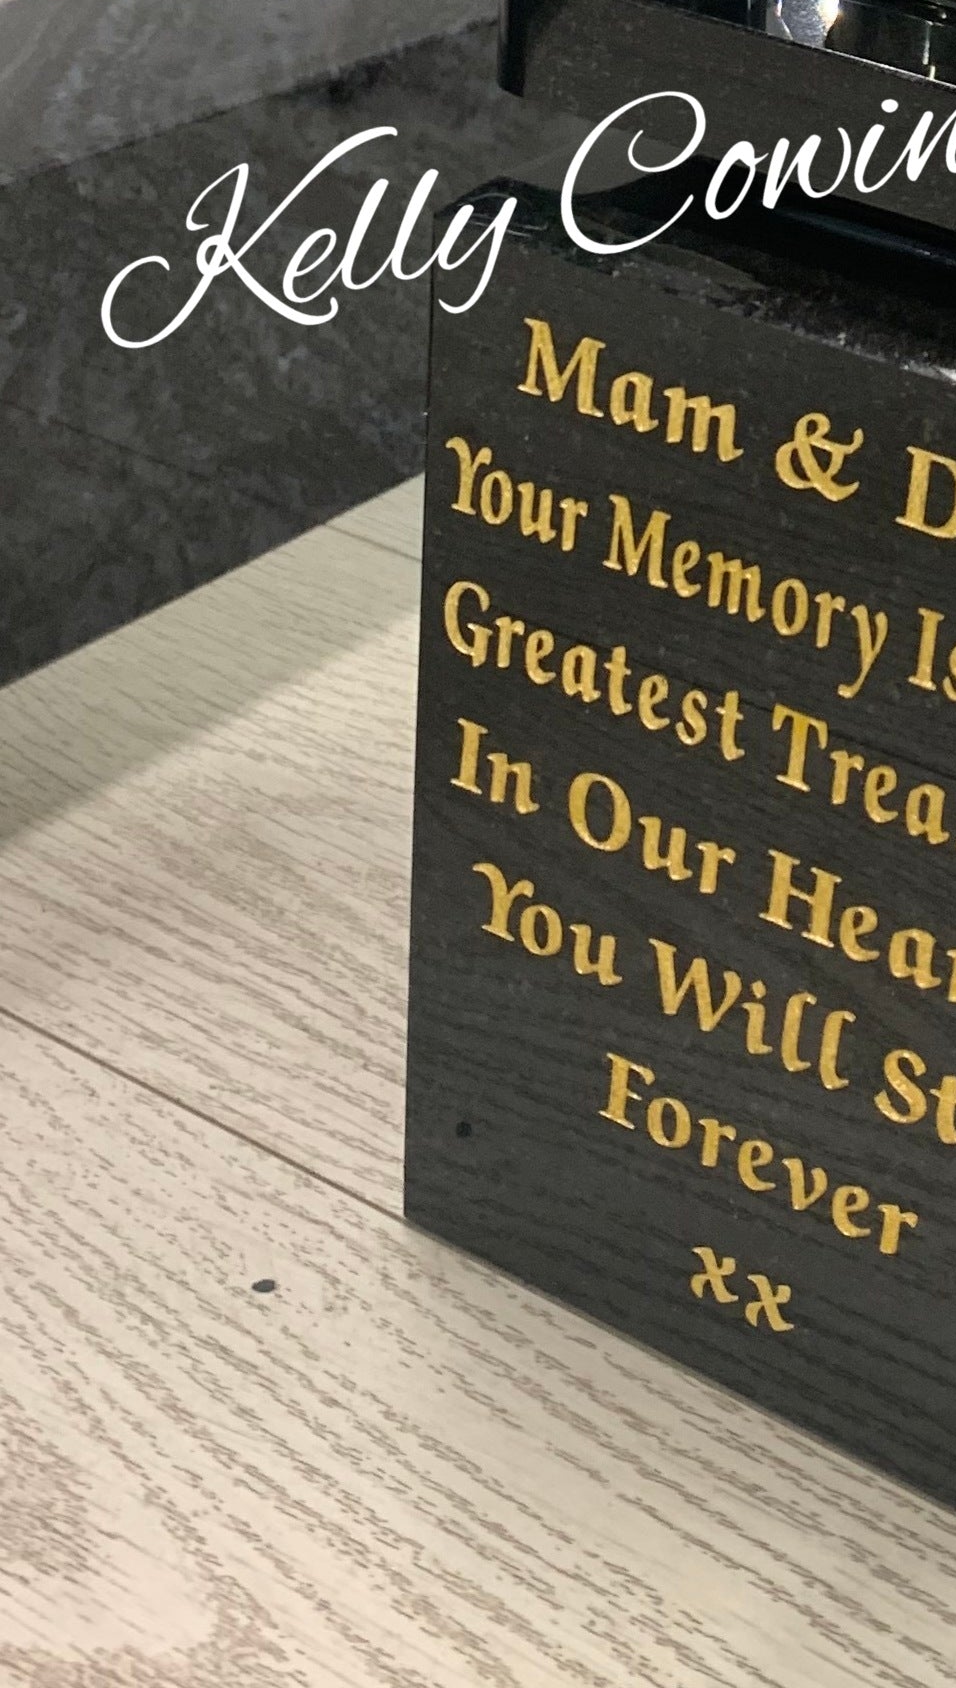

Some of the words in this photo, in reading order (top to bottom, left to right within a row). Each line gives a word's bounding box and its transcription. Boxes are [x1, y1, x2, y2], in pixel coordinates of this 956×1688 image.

[518, 316, 743, 464] Mam
[773, 411, 866, 504] &
[444, 435, 590, 553] Your
[602, 492, 890, 701] Memory
[442, 579, 746, 763] Greatest
[451, 716, 540, 816] In
[566, 770, 738, 896] Our
[470, 861, 623, 987] You
[649, 937, 857, 1092] Will
[598, 1051, 921, 1256] Forever
[688, 1245, 793, 1333] xx
